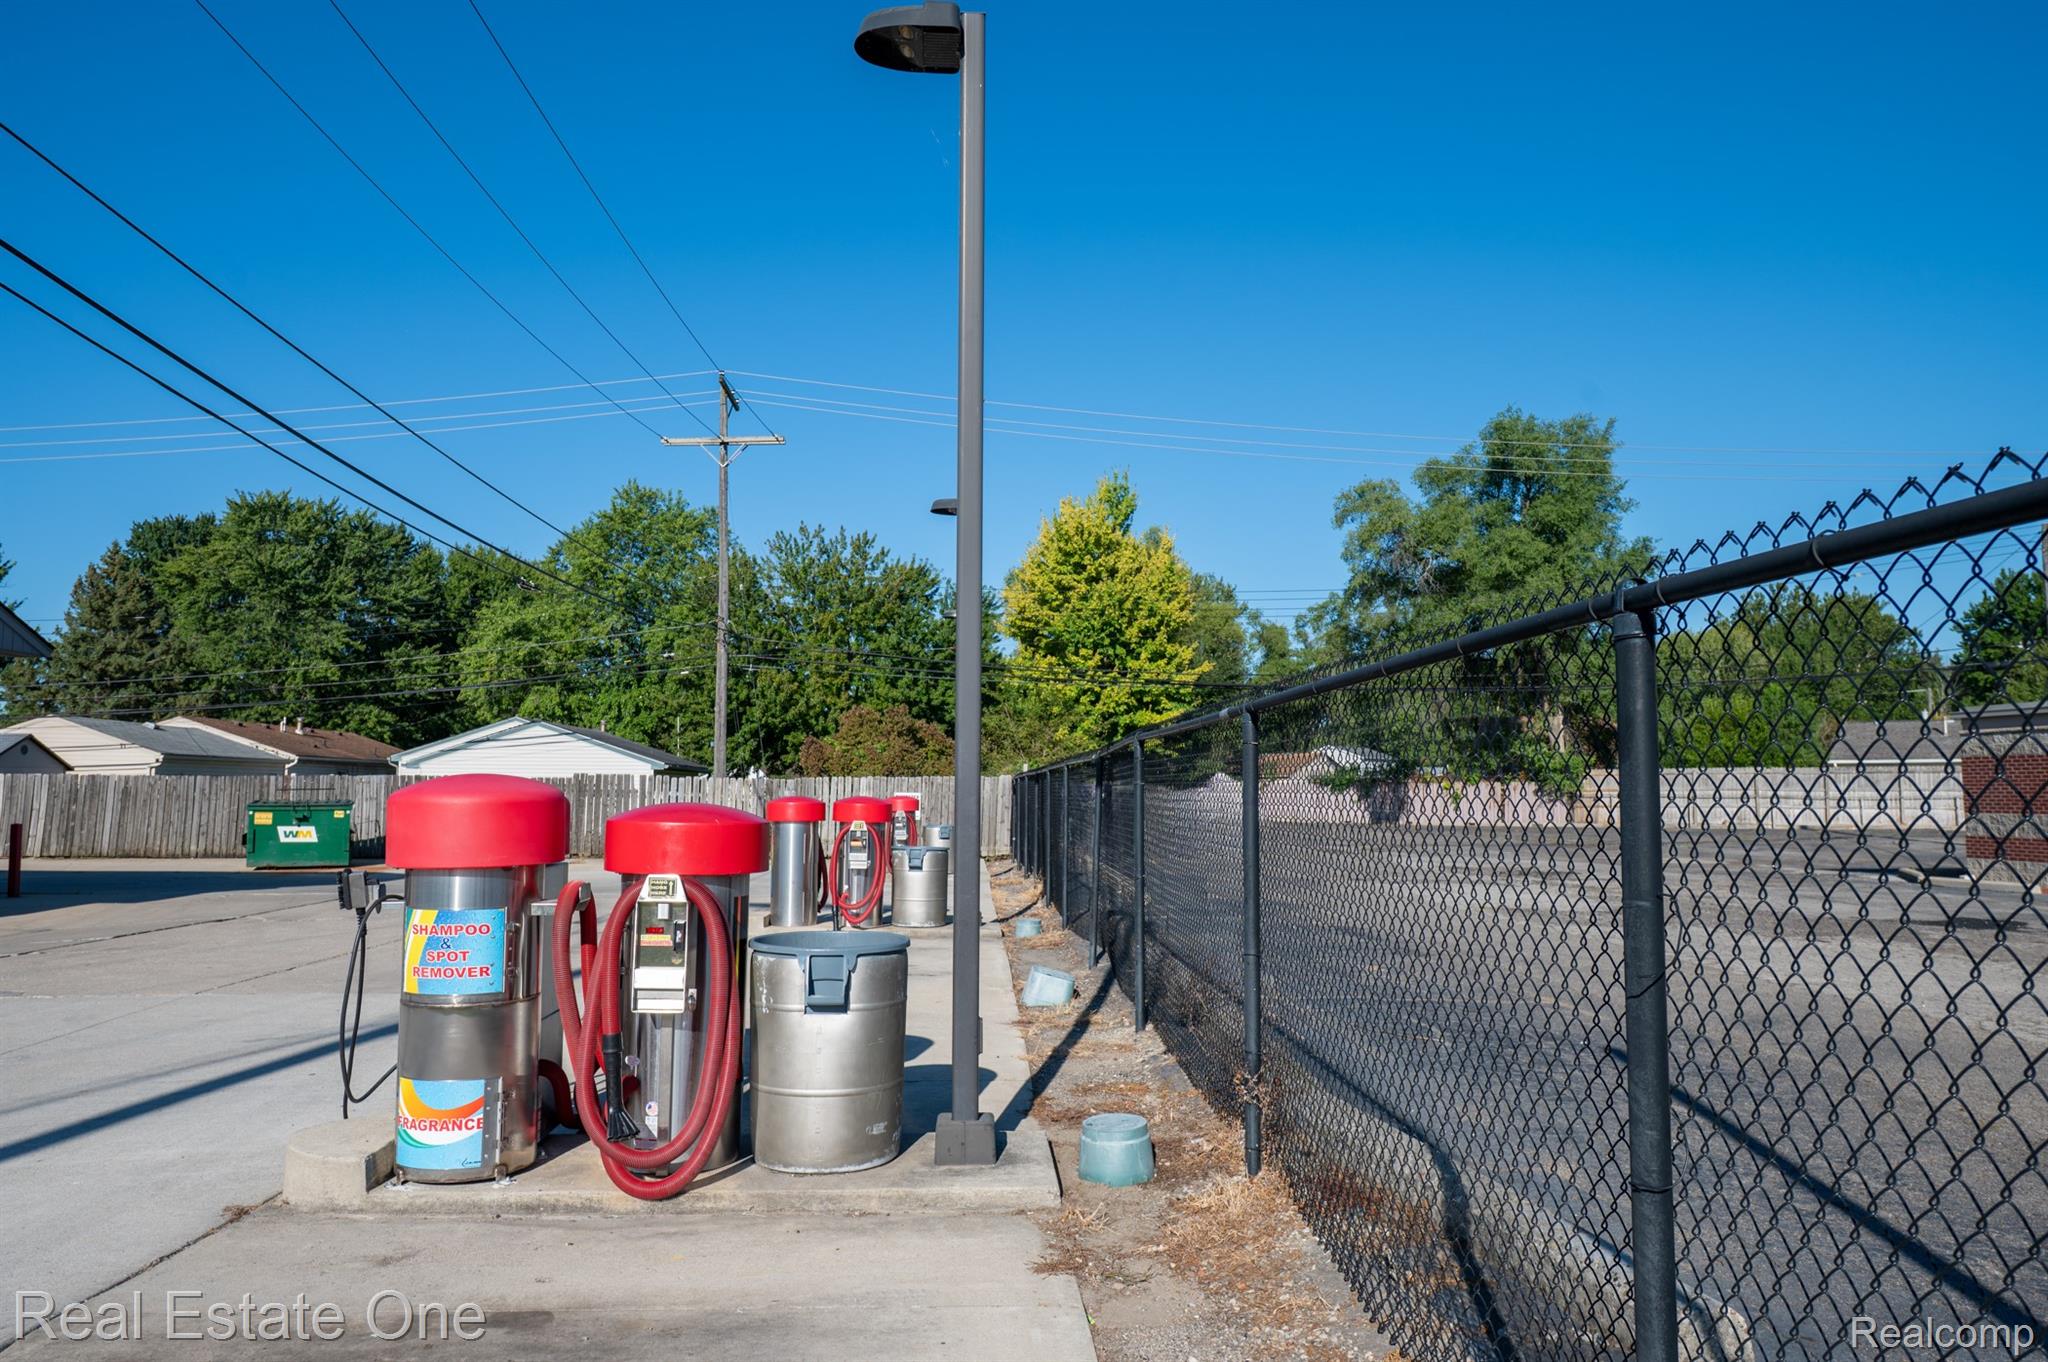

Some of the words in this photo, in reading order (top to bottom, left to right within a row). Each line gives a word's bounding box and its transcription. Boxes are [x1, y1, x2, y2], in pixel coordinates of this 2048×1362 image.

[283, 830, 313, 838] WM
[412, 924, 491, 936] SHAMPOO
[440, 938, 451, 949] &
[427, 951, 470, 962] SPOT
[412, 966, 491, 978] REMOVER
